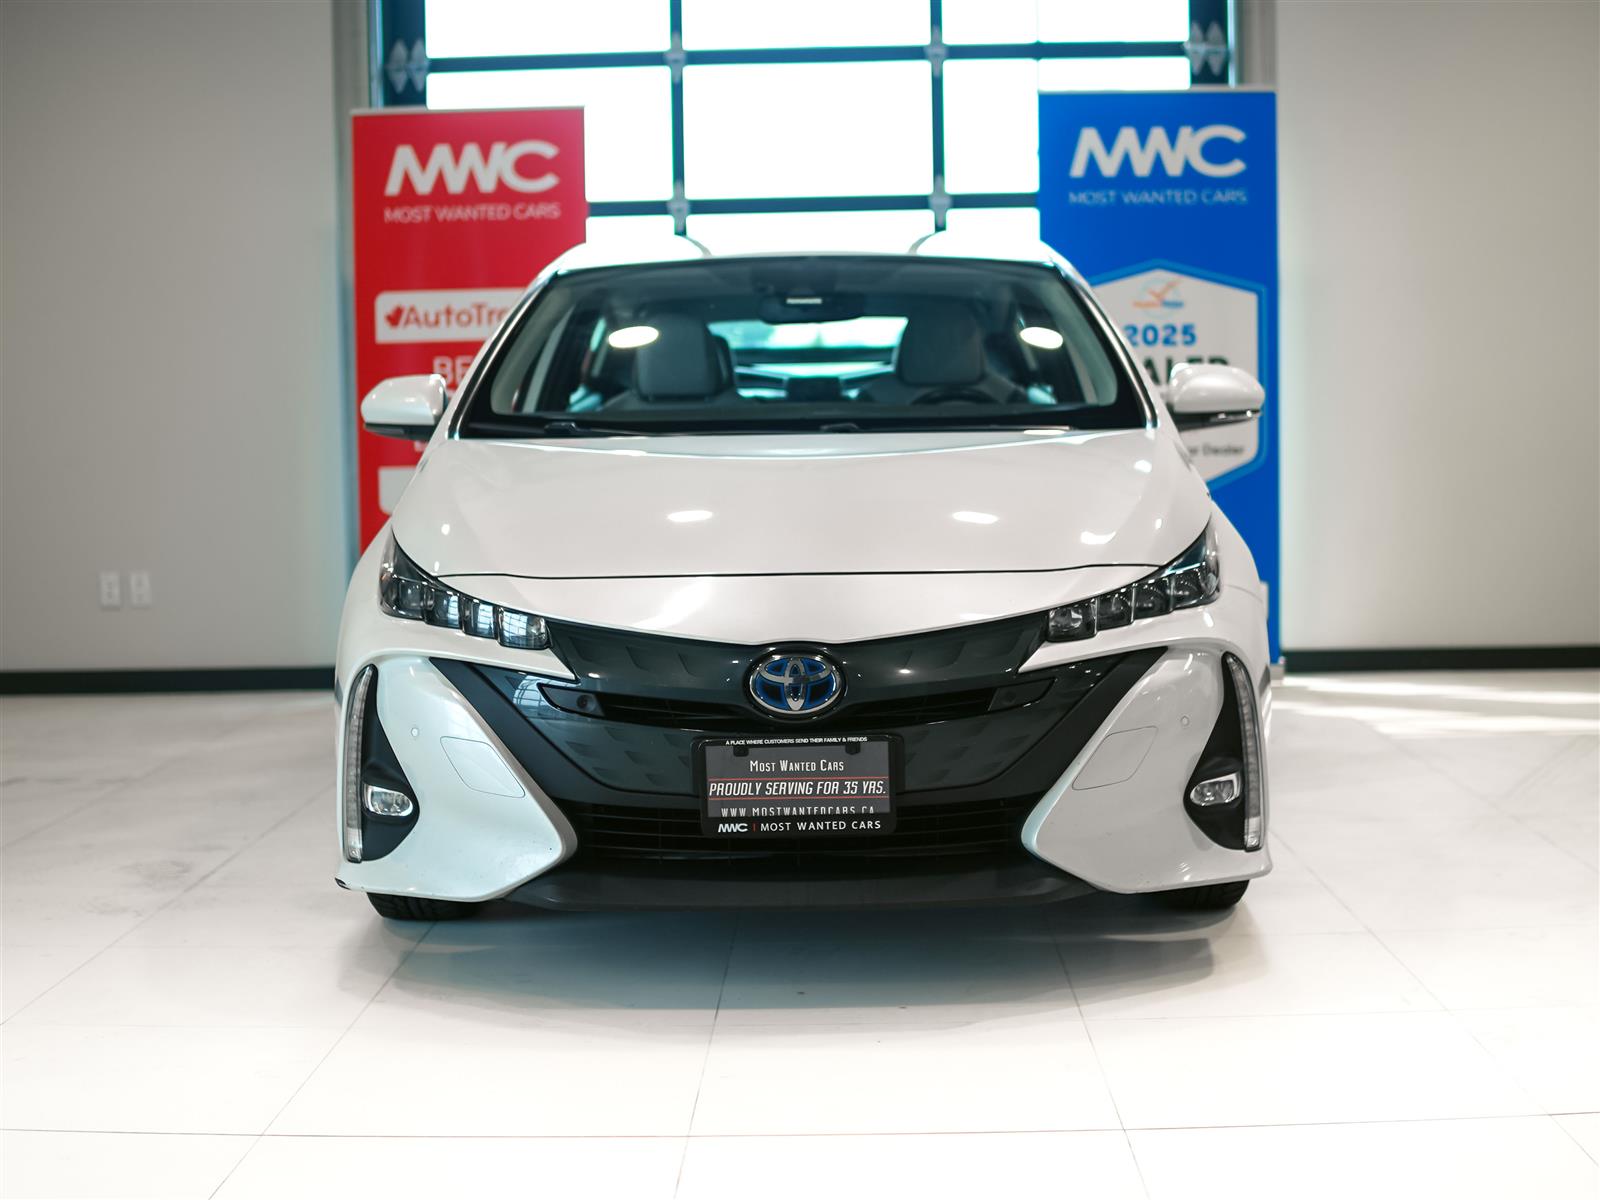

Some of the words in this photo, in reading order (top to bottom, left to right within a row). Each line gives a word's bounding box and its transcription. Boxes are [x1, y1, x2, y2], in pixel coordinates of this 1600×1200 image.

[1069, 124, 1247, 178] MWC
[384, 140, 560, 196] MWC
[1068, 189, 1117, 206] MOST
[1121, 188, 1197, 205] WANTED
[1201, 188, 1248, 205] CARS
[384, 205, 431, 224] MOST
[435, 204, 511, 222] WANTED
[513, 202, 561, 220] CARS
[1123, 322, 1197, 346] 2025
[708, 782, 762, 796] PROUDLY
[765, 781, 813, 796] SERVING
[816, 781, 840, 795] FOR
[843, 781, 859, 795] 35
[862, 780, 887, 795] YRS.
[717, 823, 749, 833] MWC
[760, 822, 791, 832] MOST
[797, 821, 847, 831] WANTED
[851, 820, 881, 830] CARS
